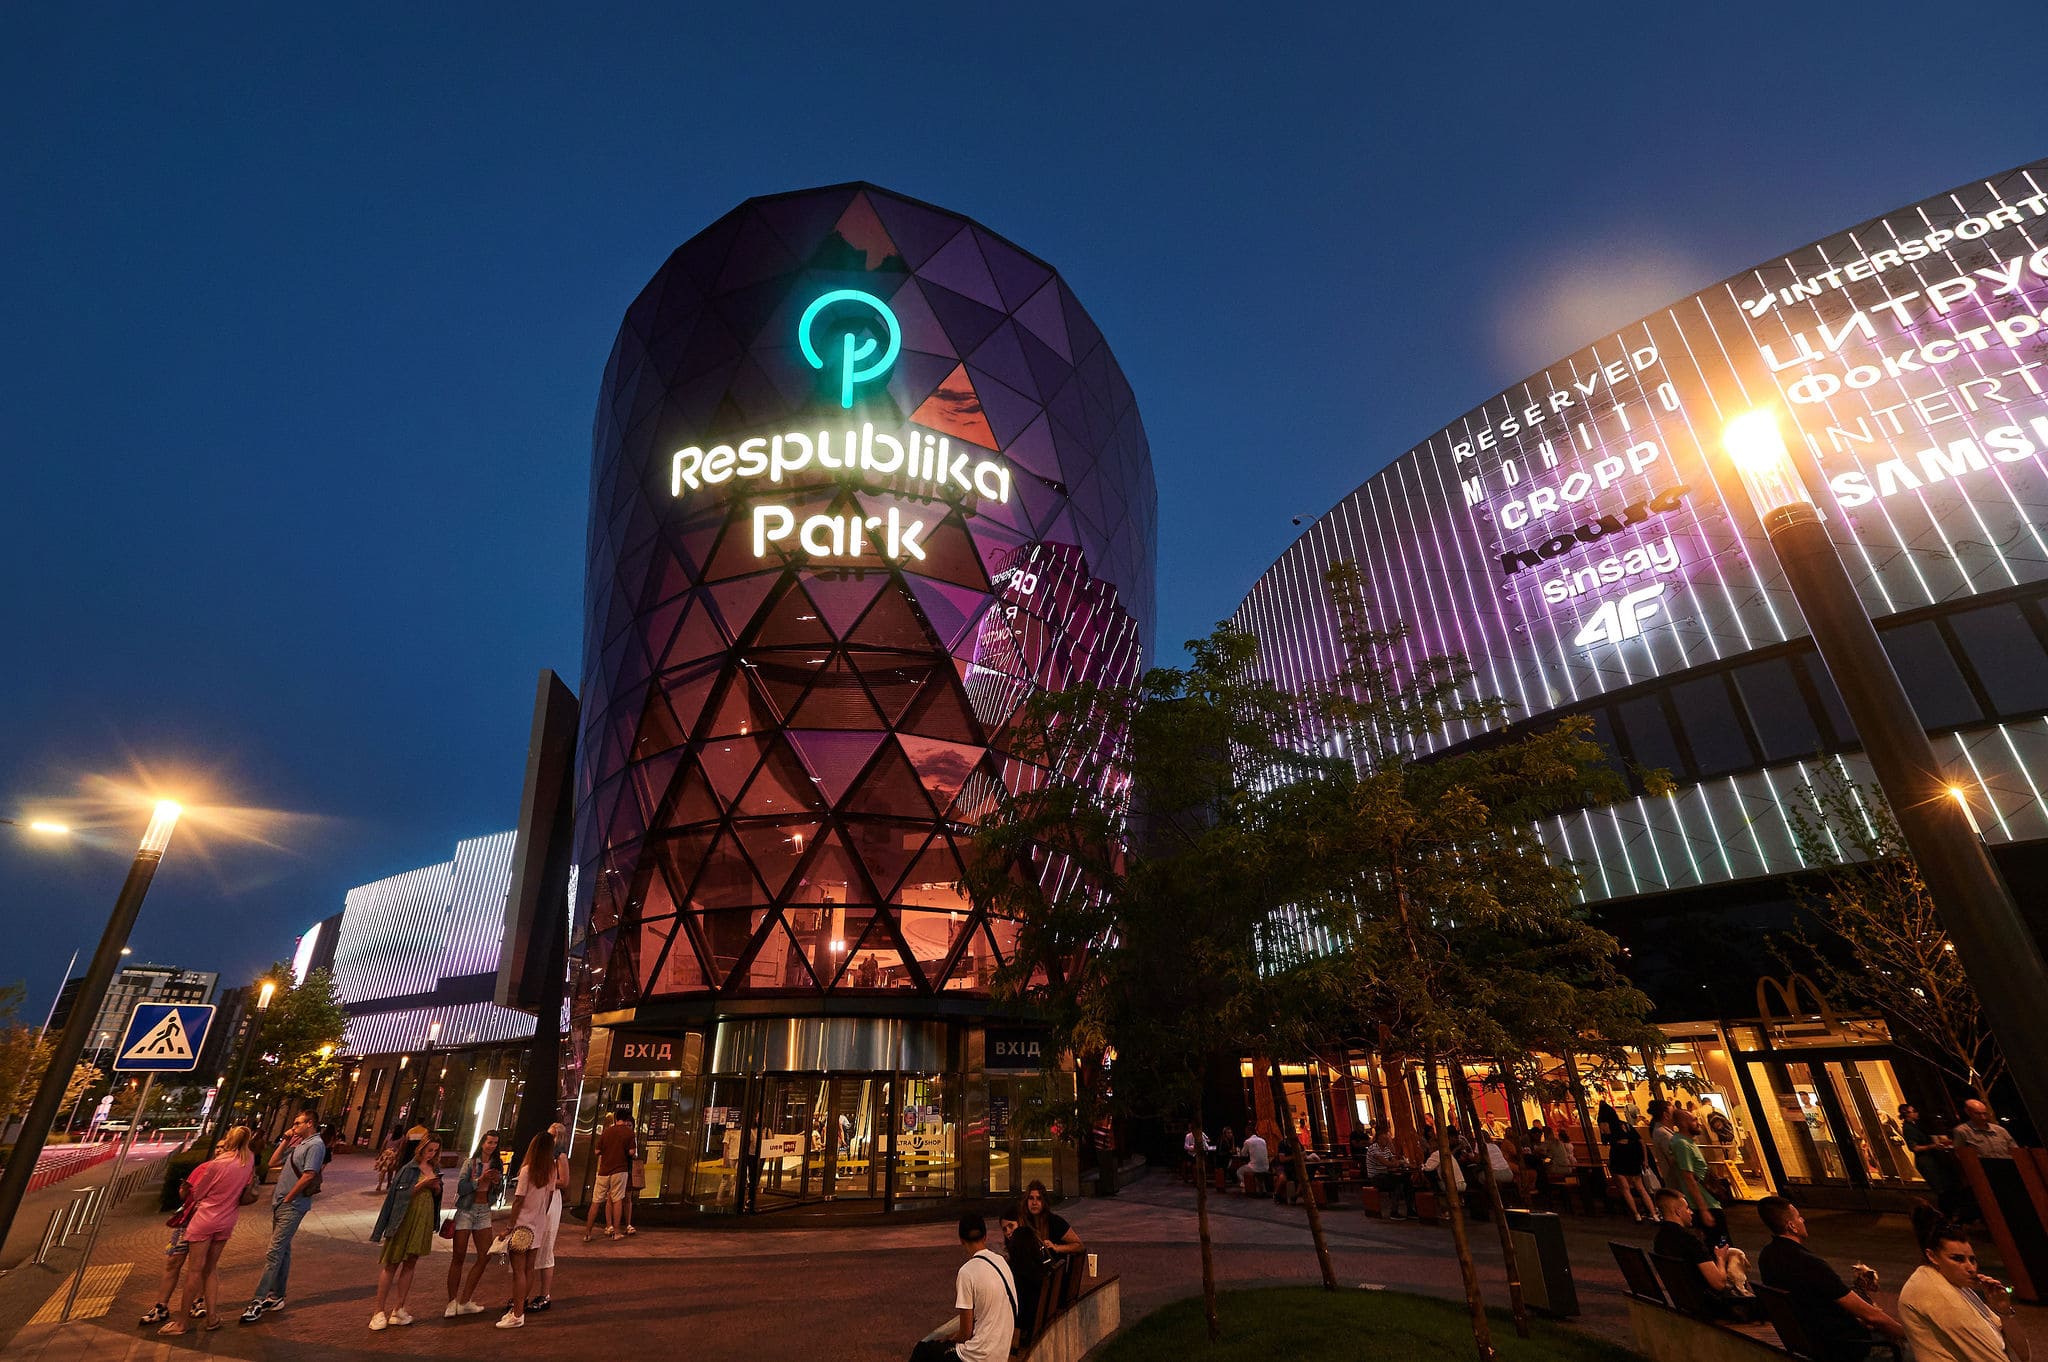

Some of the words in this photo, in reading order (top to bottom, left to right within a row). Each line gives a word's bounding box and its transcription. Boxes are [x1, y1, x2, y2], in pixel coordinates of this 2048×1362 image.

[1773, 192, 2048, 305] INTERSPORT
[1786, 308, 2048, 404] Фокстр
[1453, 346, 1660, 464] RESERVED
[1462, 381, 1681, 507] MOHITO
[670, 421, 1011, 504] Respublika
[1500, 440, 1660, 530] CROPP
[752, 504, 927, 561] Park
[1500, 484, 1692, 576] house
[1543, 536, 1681, 604] sinsay
[1573, 581, 1666, 647] 4F
[623, 1043, 673, 1061] ВХІД
[995, 1041, 1041, 1058] ВХІД
